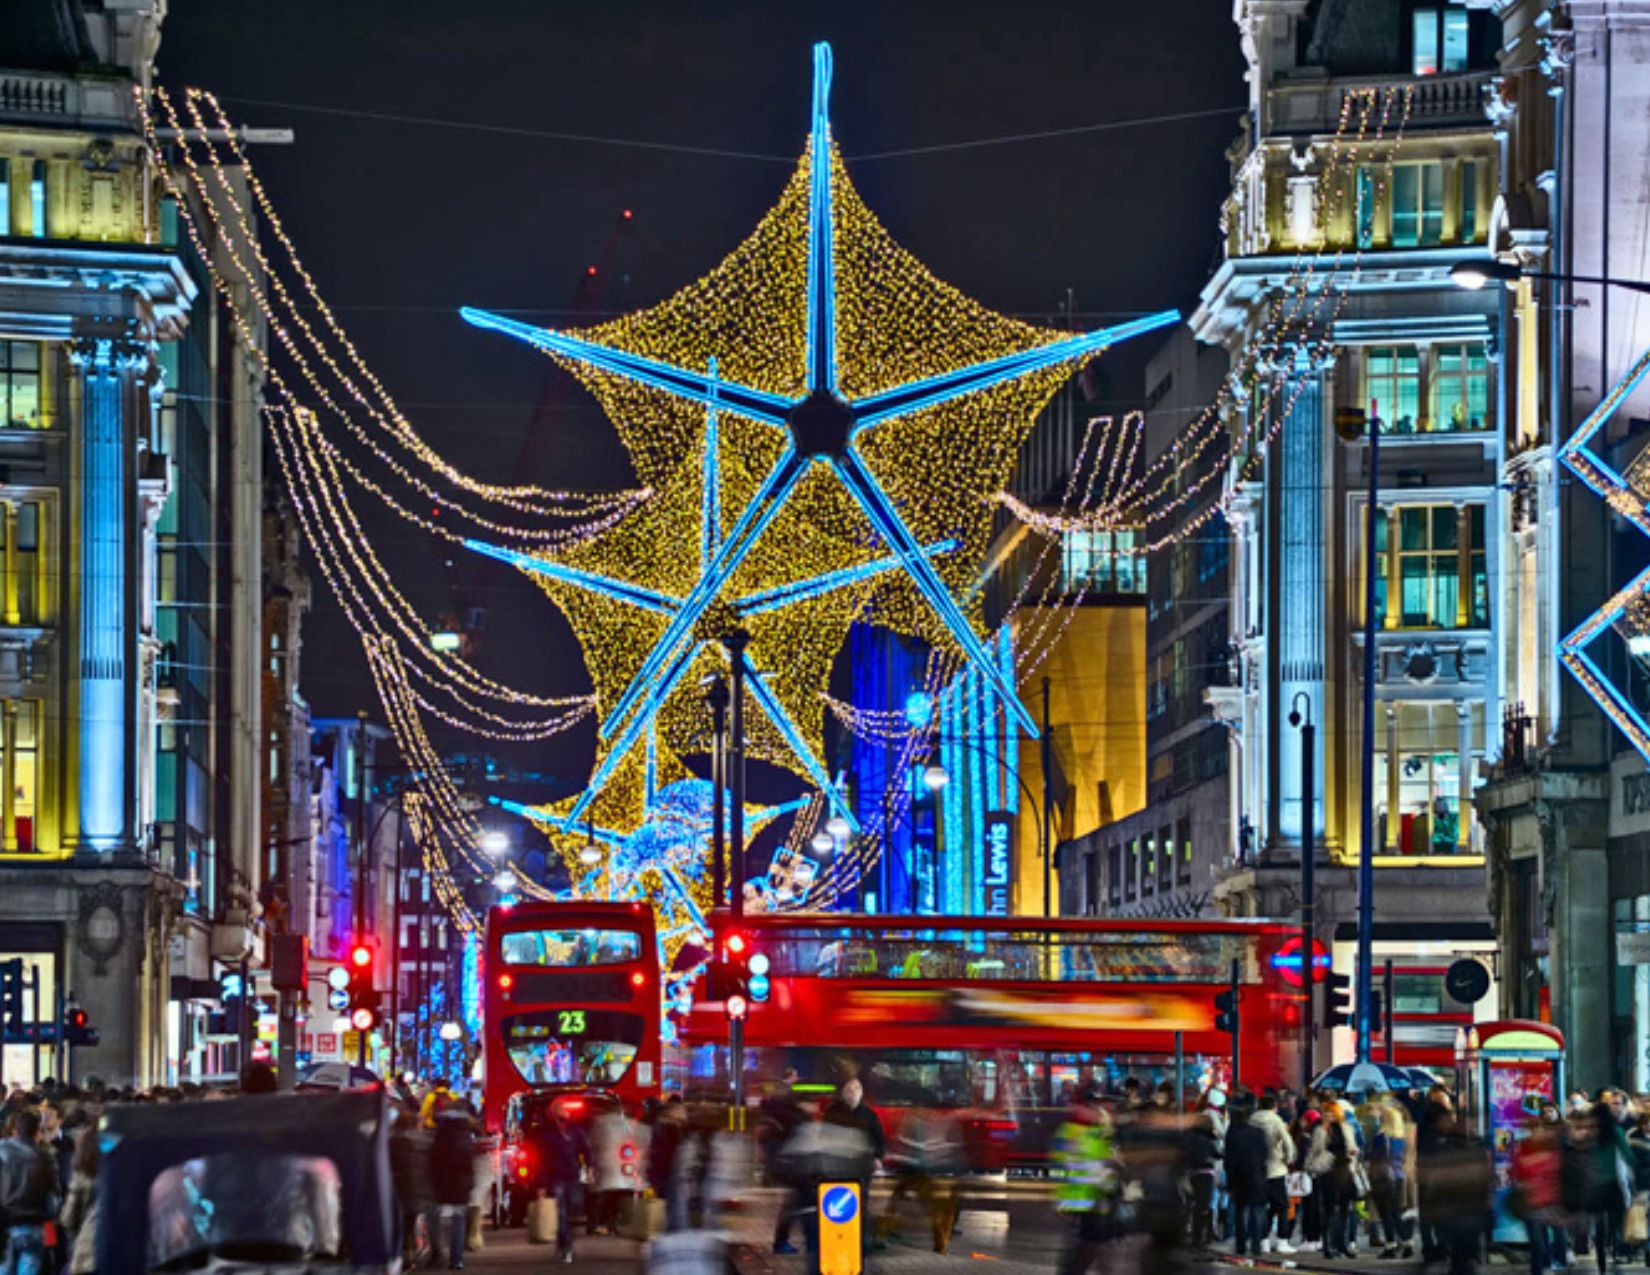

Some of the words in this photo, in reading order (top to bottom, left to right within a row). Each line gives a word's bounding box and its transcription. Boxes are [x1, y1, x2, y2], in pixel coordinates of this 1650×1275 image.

[985, 822, 1008, 885] Lewis
[986, 888, 1007, 915] hn
[558, 1010, 585, 1034] 23
